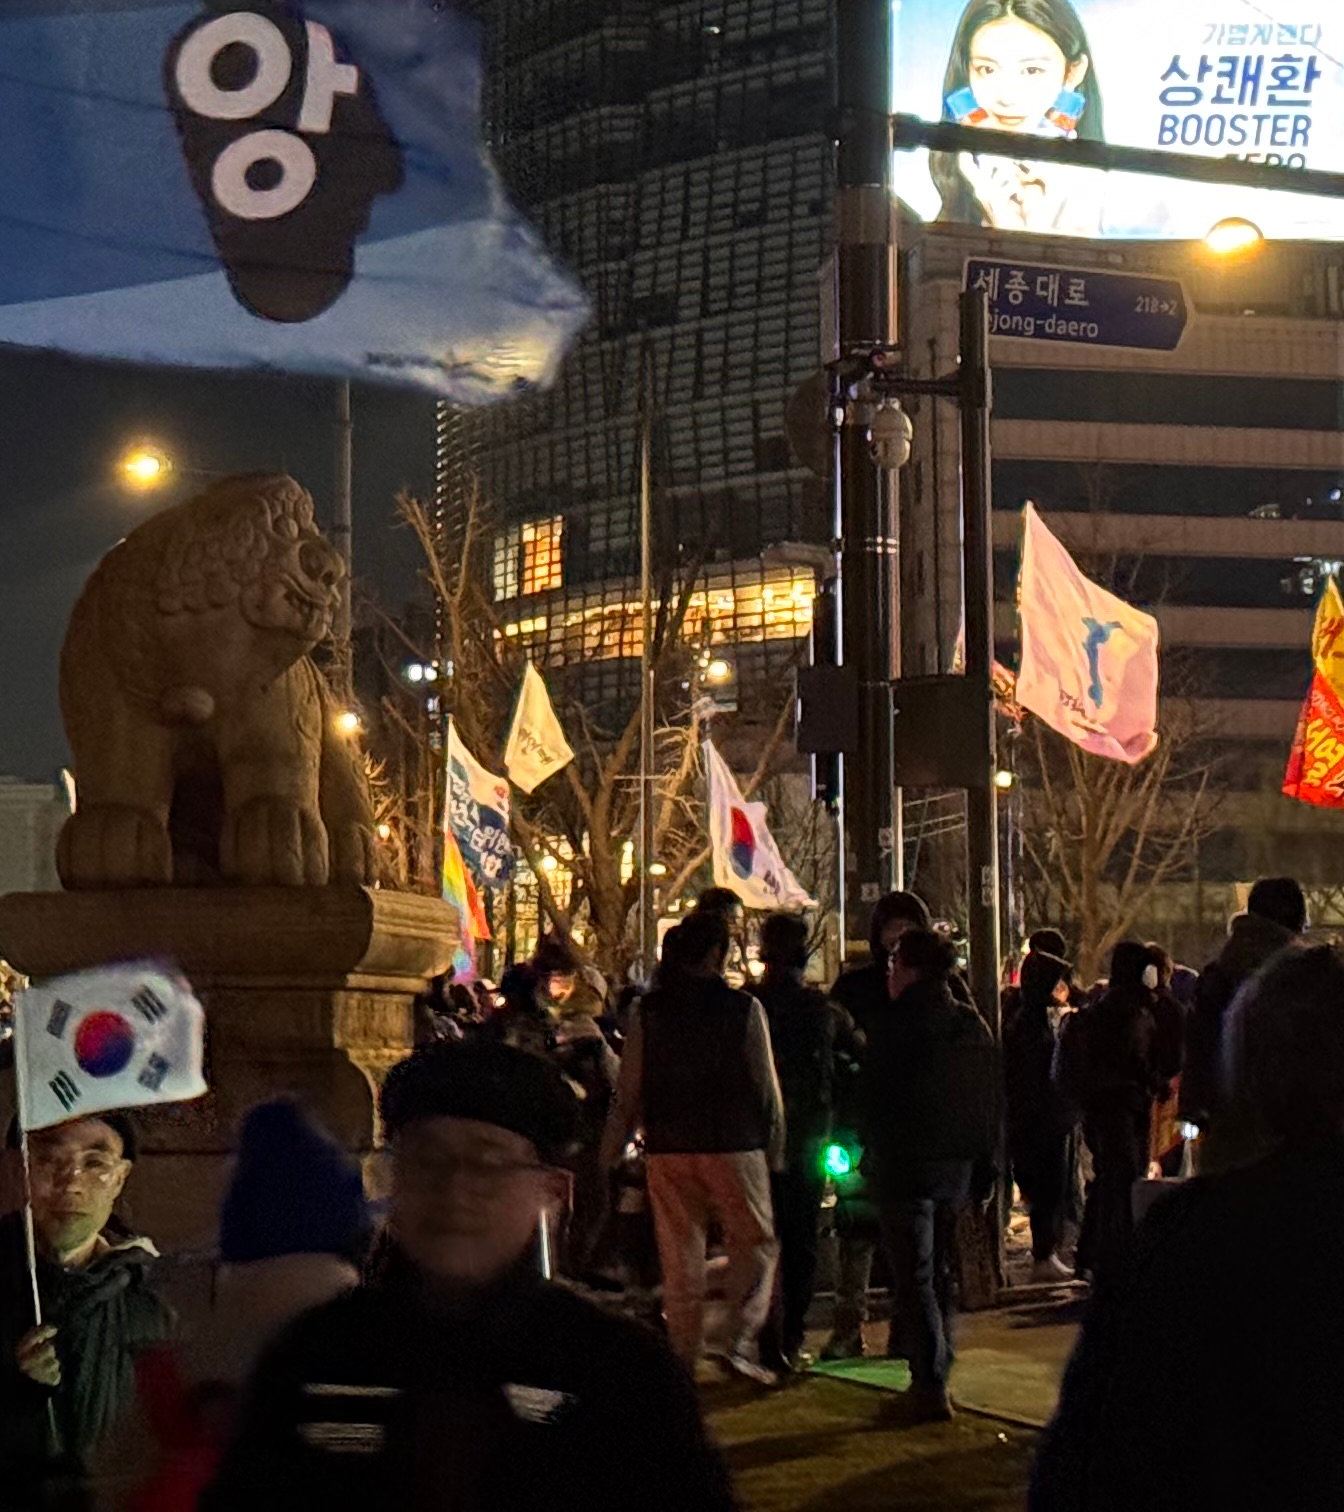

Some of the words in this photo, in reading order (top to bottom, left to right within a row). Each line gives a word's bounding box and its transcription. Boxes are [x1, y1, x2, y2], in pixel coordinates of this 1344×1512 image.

[1158, 53, 1322, 107] 상쾌환
[176, 11, 360, 220] 앙
[1157, 113, 1312, 147] BOOSTER
[973, 268, 1090, 307] 세종대로
[987, 308, 1099, 338] jong-daero
